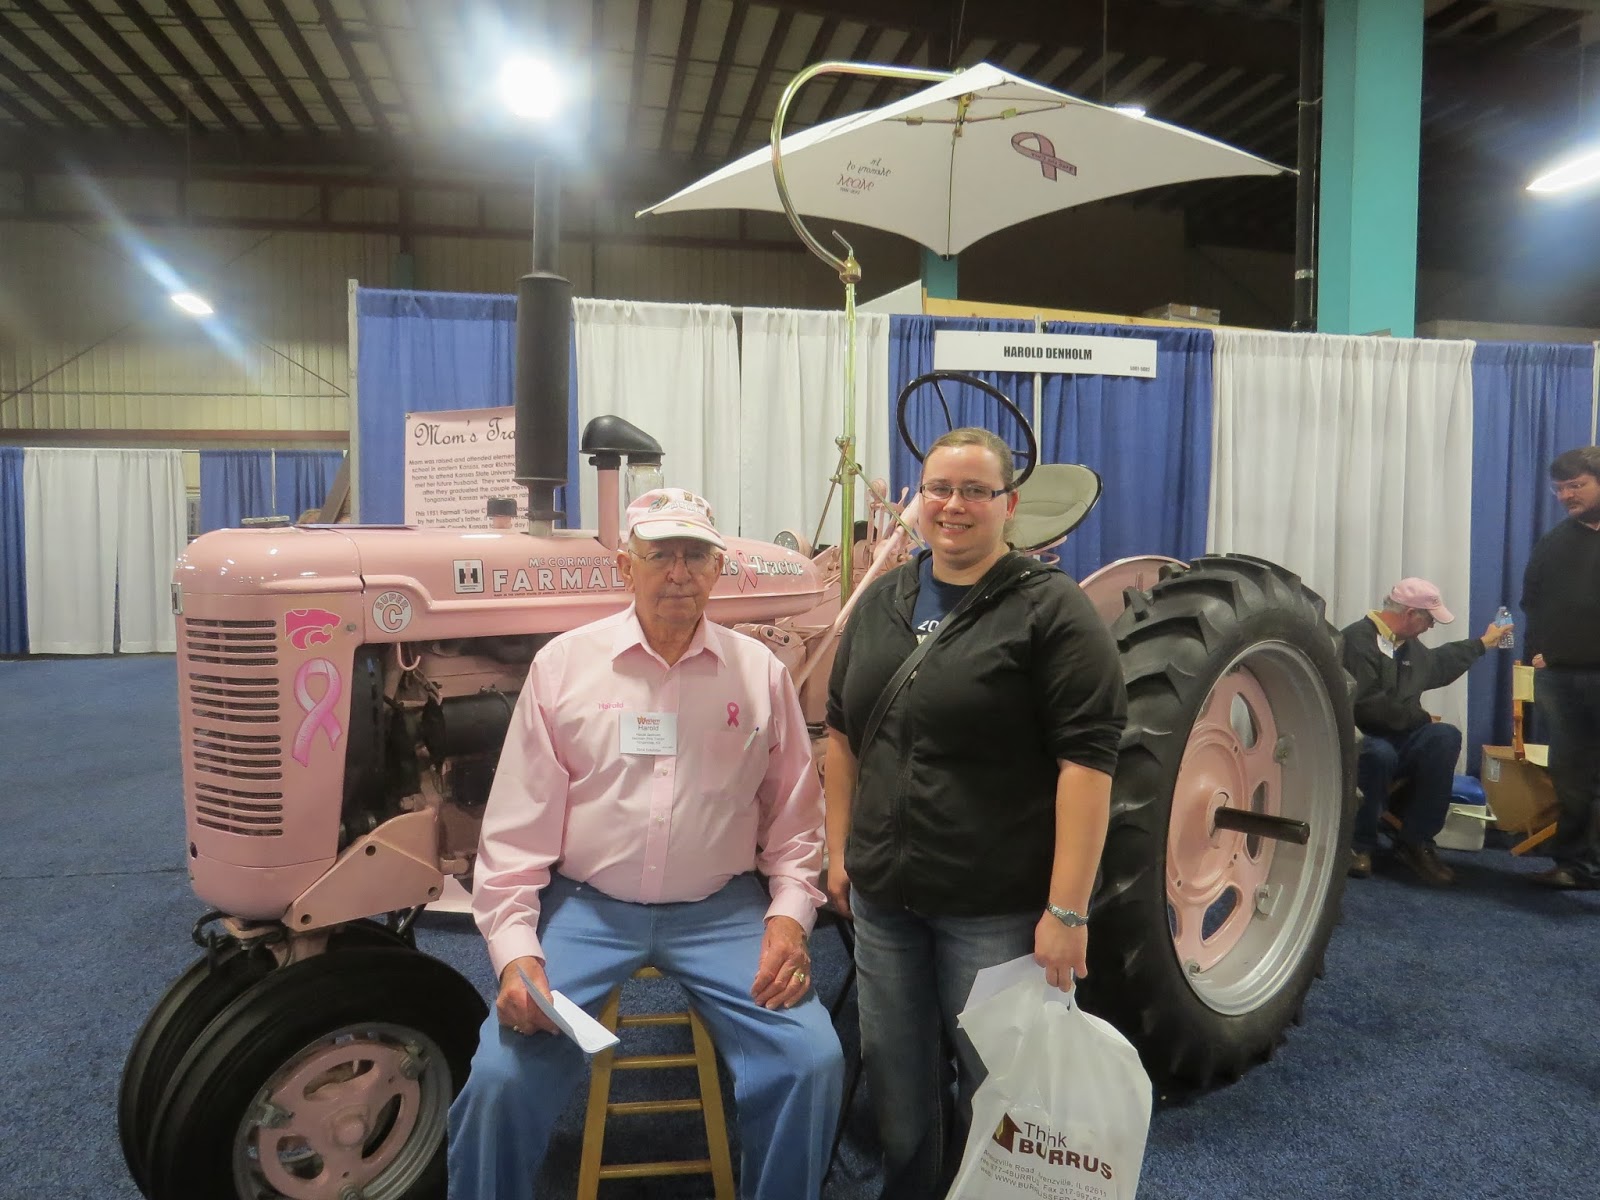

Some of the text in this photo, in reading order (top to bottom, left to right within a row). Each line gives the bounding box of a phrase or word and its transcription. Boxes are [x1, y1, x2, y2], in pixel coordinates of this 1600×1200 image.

[1004, 346, 1092, 360] HAROLD DENHOLM
[414, 420, 478, 446] Mom's
[449, 486, 478, 495] graduated
[749, 555, 804, 576] Tractor
[492, 567, 626, 592] FARMAL
[375, 593, 409, 610] SUPER
[382, 604, 403, 630] C
[1024, 1121, 1067, 1148] Think
[1019, 1138, 1113, 1180] BURRUS
[1015, 1164, 1035, 1174] Road
[1076, 1182, 1082, 1190] IL
[1084, 1185, 1107, 1197] 62611
[1043, 1185, 1057, 1193] Fax
